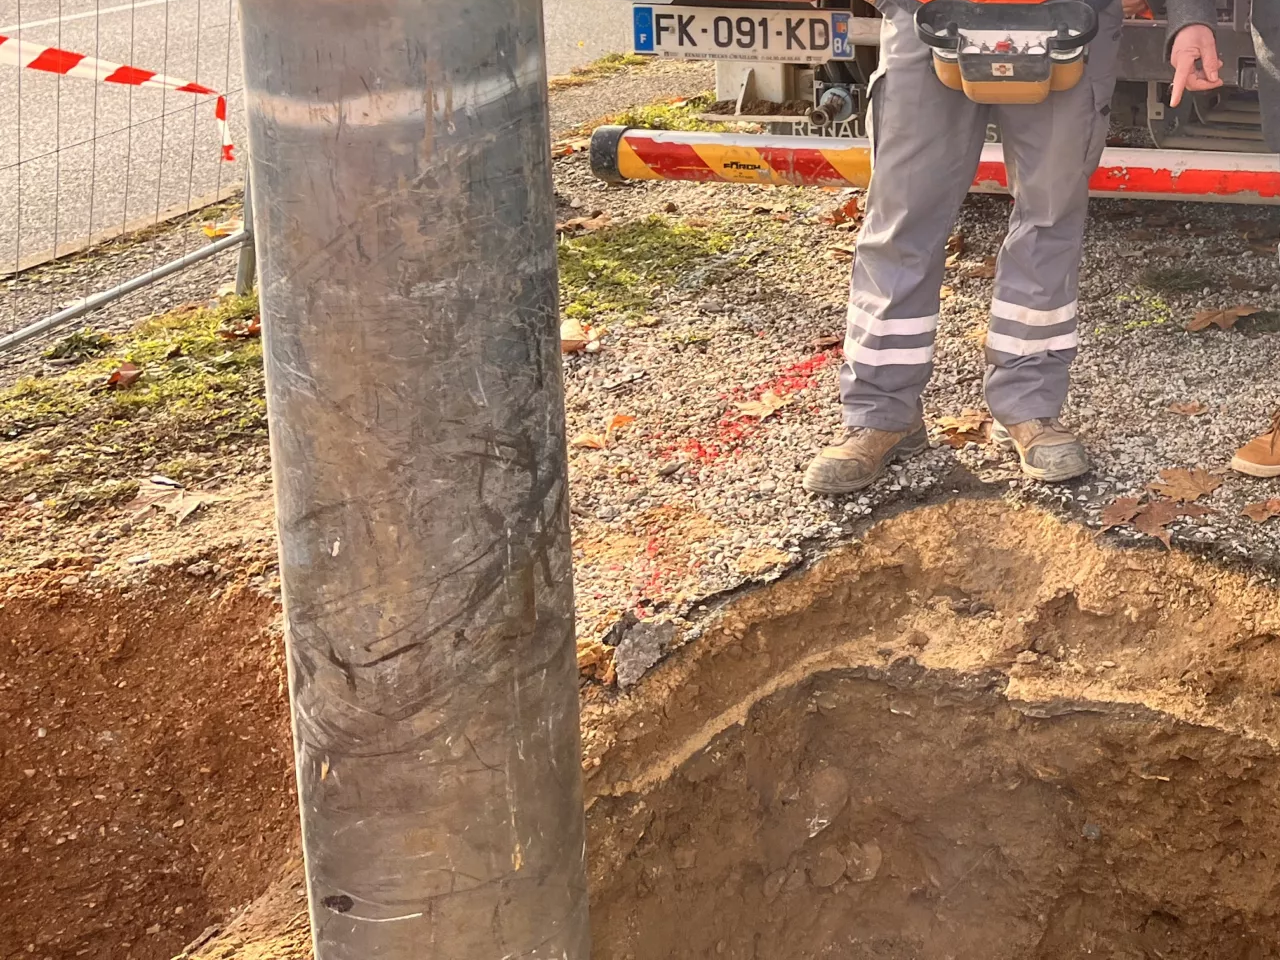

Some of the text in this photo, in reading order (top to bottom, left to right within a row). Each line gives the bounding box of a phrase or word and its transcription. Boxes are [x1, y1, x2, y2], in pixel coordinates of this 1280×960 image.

[640, 33, 647, 44] F
[655, 13, 830, 51] FK-091-KD
[791, 120, 868, 138] RENAU
